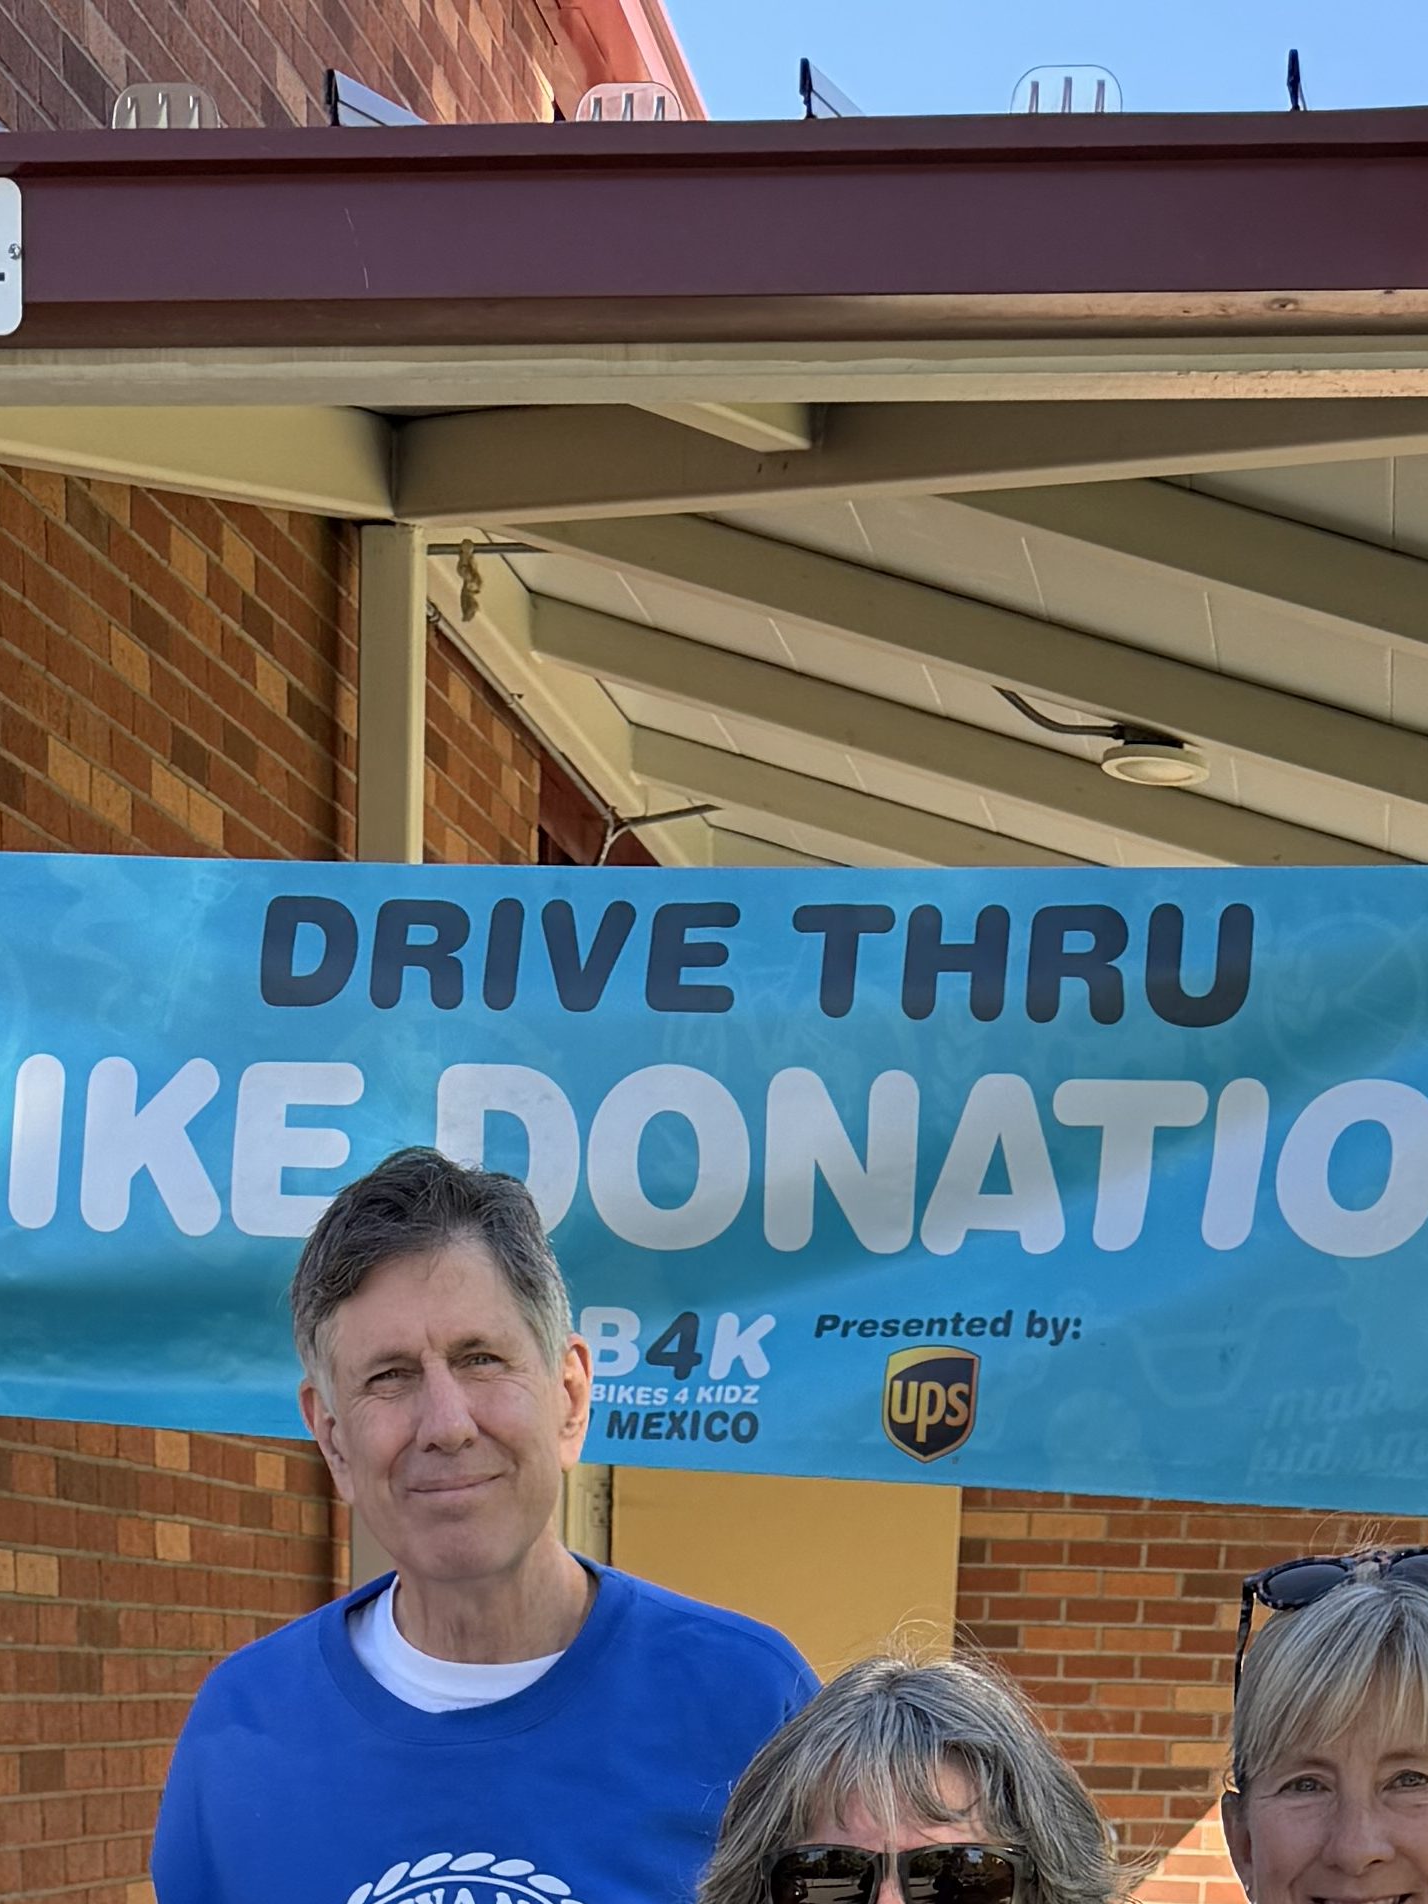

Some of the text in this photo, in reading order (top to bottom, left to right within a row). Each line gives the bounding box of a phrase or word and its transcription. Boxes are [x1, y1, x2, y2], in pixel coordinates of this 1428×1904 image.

[260, 895, 1254, 1028] DRIVE THRU
[579, 1307, 776, 1381] B4K
[814, 1309, 1083, 1346] Presented by:
[591, 1384, 760, 1406] BIKES 4 KIDZ
[890, 1379, 970, 1443] ups
[606, 1410, 759, 1444] MEXICO
